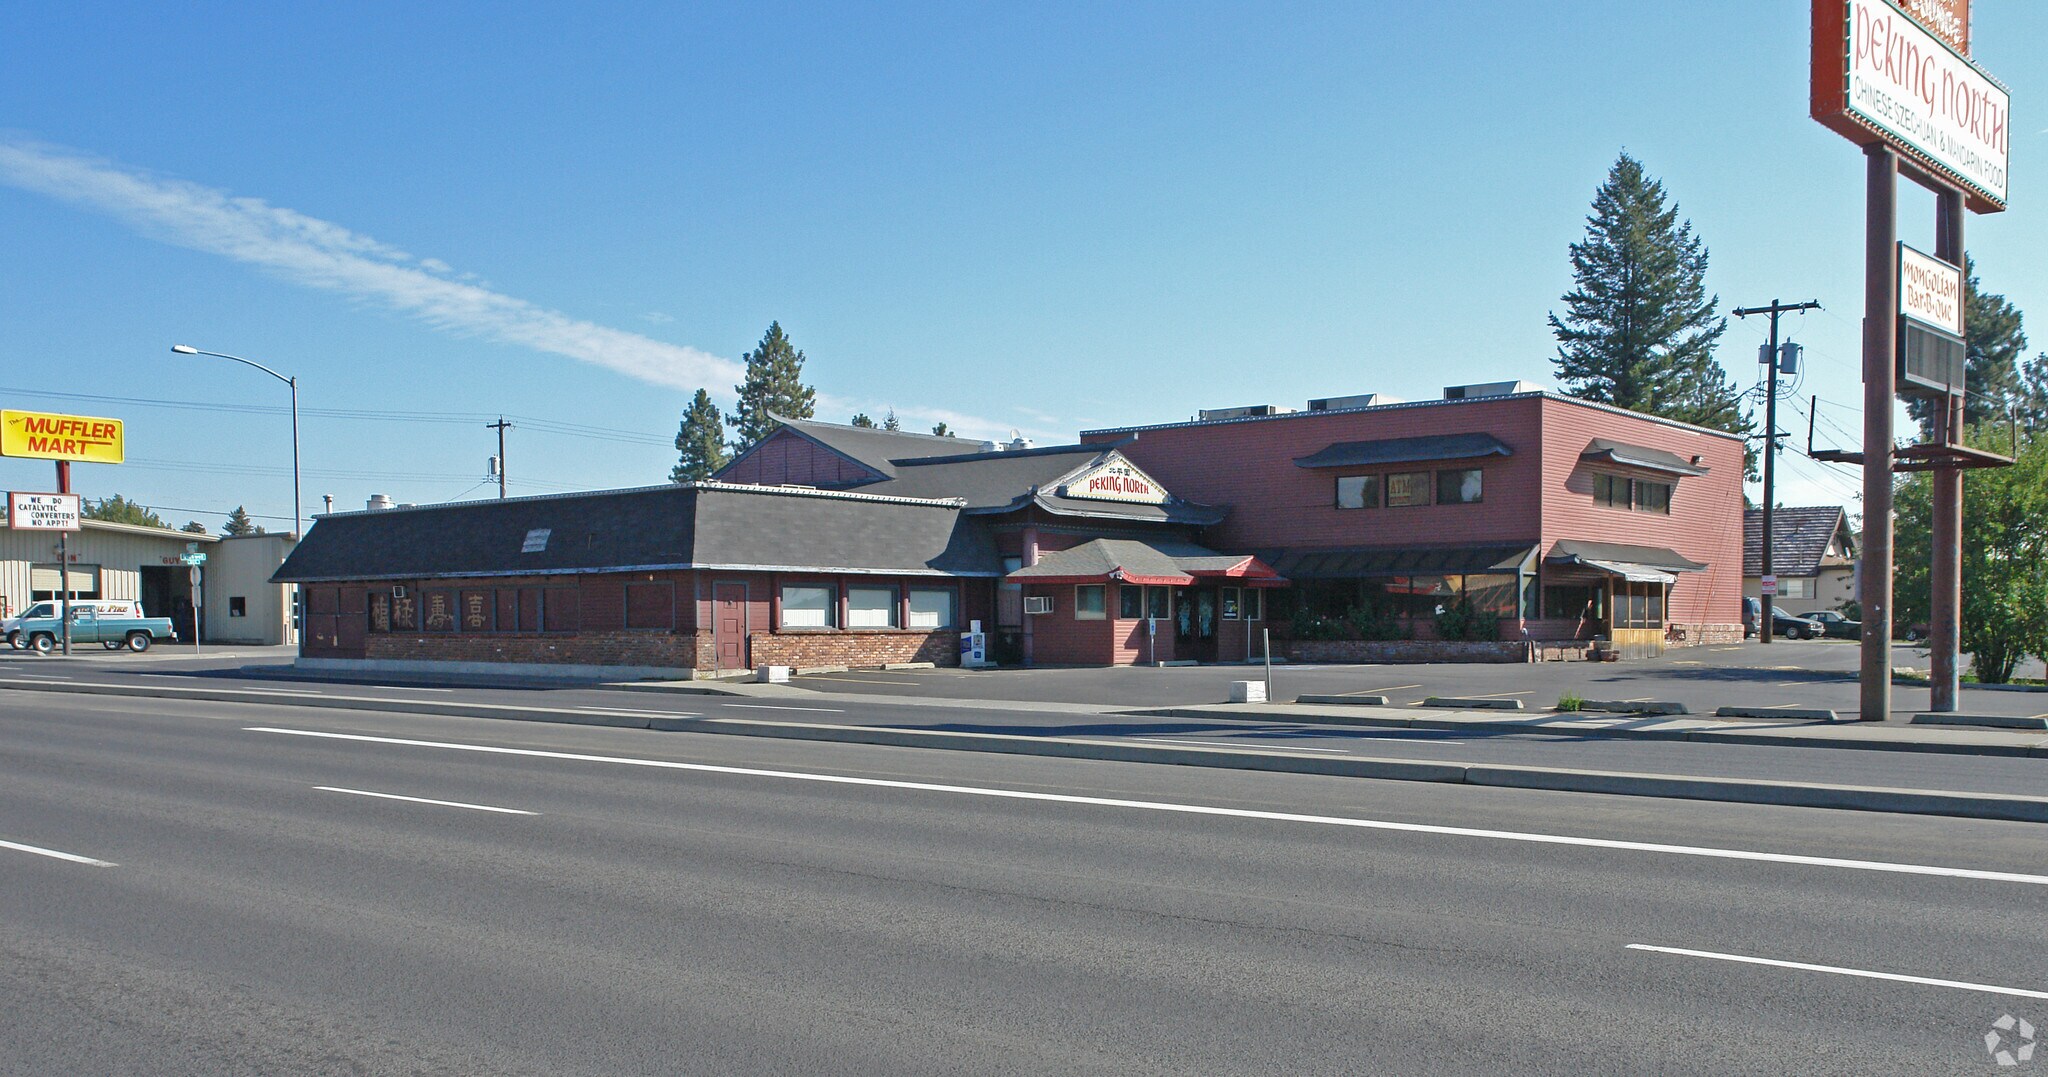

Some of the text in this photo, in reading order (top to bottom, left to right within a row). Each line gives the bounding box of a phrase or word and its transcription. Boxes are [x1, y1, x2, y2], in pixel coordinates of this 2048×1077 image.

[1855, 3, 2006, 156] PEKING NORTH
[1855, 76, 2004, 189] CHINESE SZECHUAN & MANDARIN FOOD
[25, 417, 116, 439] MUFFLER
[28, 436, 112, 455] MART
[1089, 476, 1149, 494] PEKING NORTH
[1390, 479, 1410, 494] ATM
[19, 503, 57, 511] CATALYTIC
[31, 496, 41, 504] WE
[31, 511, 75, 519] CONVERTERS
